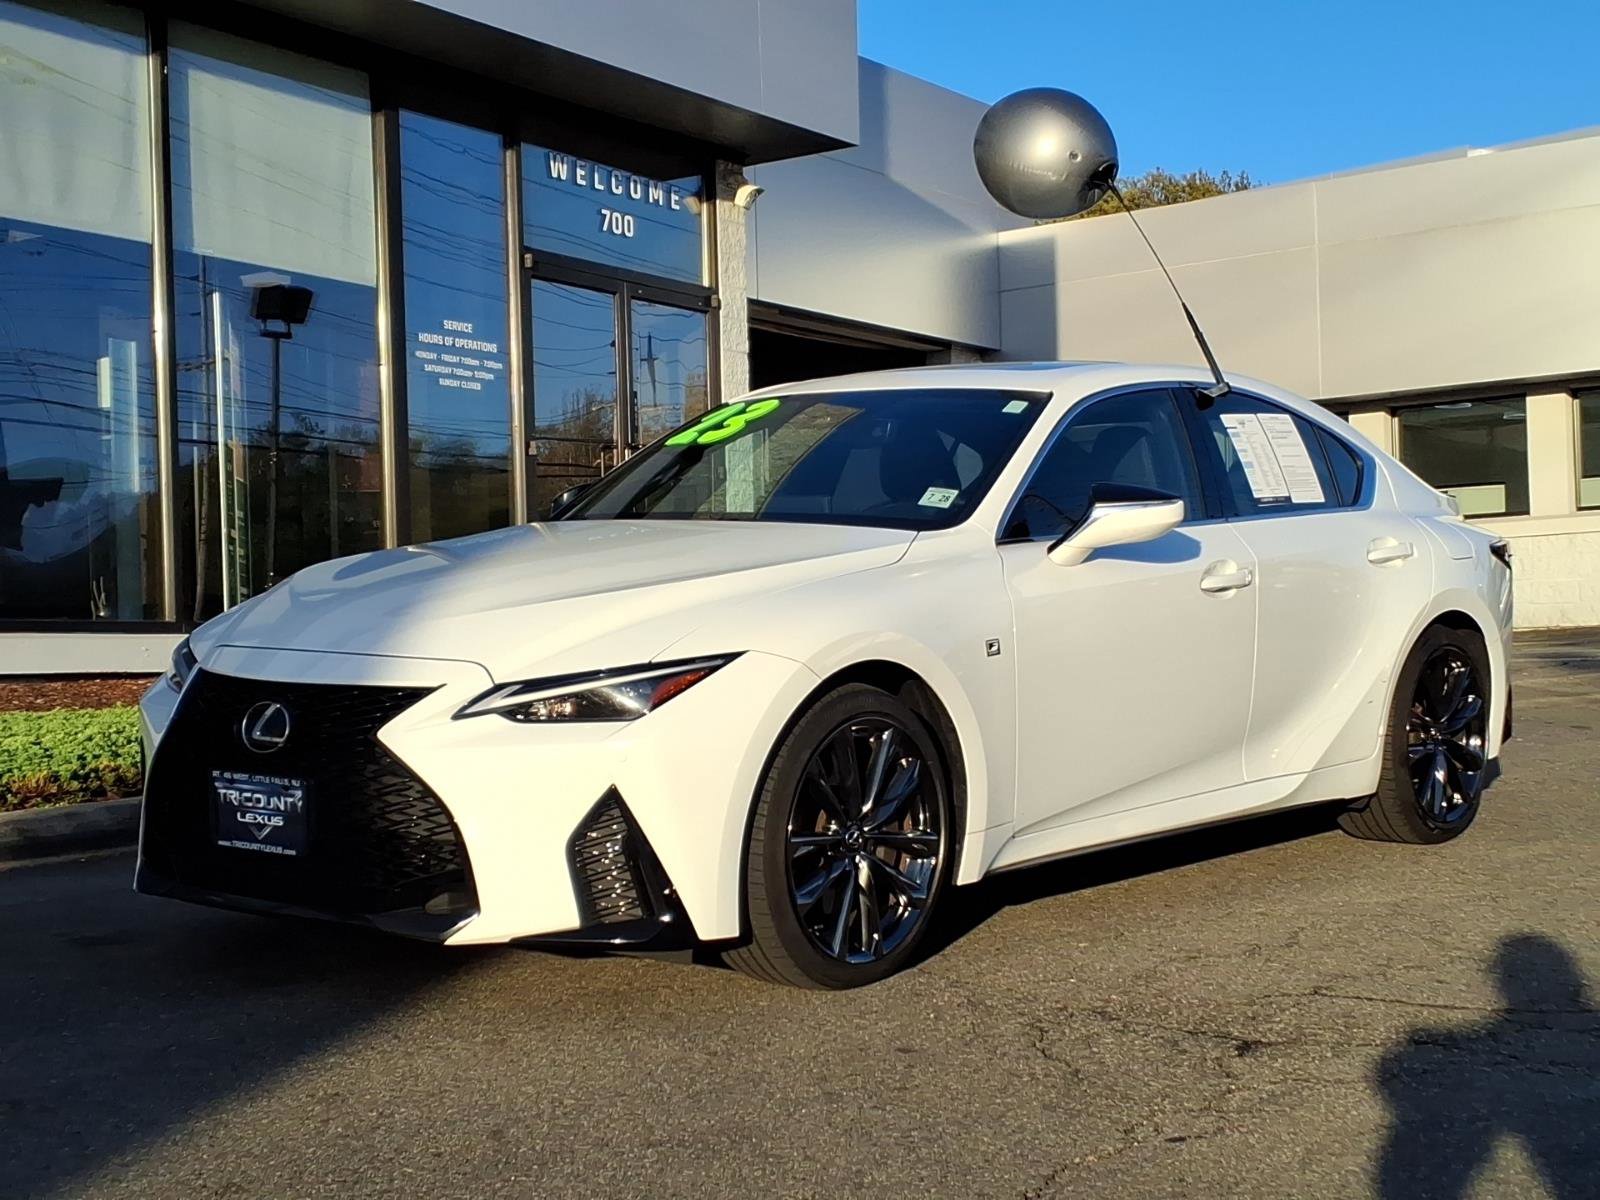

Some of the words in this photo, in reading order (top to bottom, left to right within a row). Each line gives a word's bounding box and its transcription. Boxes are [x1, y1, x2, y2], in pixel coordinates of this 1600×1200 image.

[548, 151, 680, 211] WELCOME
[601, 208, 634, 238] 700
[443, 320, 473, 333] SERVICE
[419, 333, 443, 345] HOURS
[444, 337, 453, 346] OF
[455, 338, 497, 353] OPERATIONS
[441, 354, 460, 363] FRIDAY
[424, 364, 452, 374] SATURDAY
[461, 380, 481, 390] CLOSED
[237, 812, 284, 826] LEXUS
